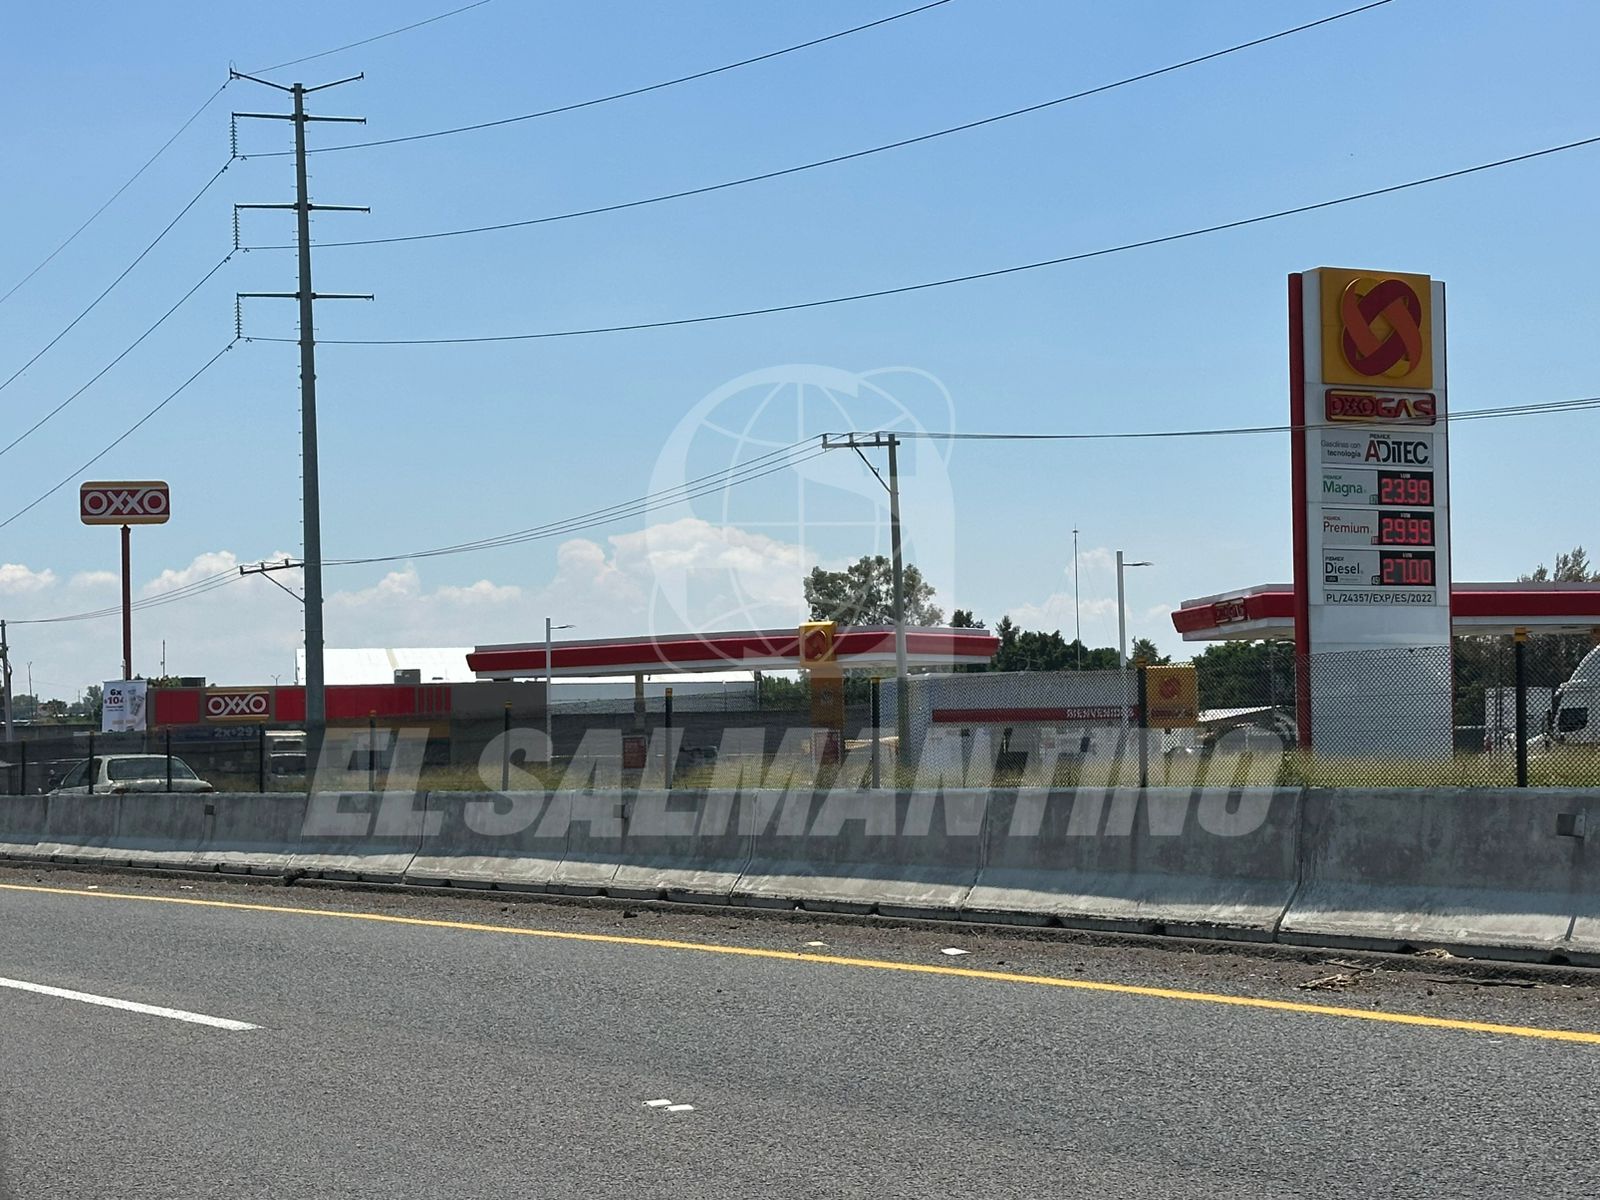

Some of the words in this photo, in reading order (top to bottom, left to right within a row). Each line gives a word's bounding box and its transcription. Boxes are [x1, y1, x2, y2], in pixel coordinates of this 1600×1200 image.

[1323, 480, 1363, 497] Magna
[84, 490, 167, 516] OXXO
[1323, 521, 1370, 534] Premium
[1325, 562, 1360, 575] Diesel
[1326, 594, 1432, 603] PL/24357/EXP/ES/2022
[208, 693, 267, 716] OXXO
